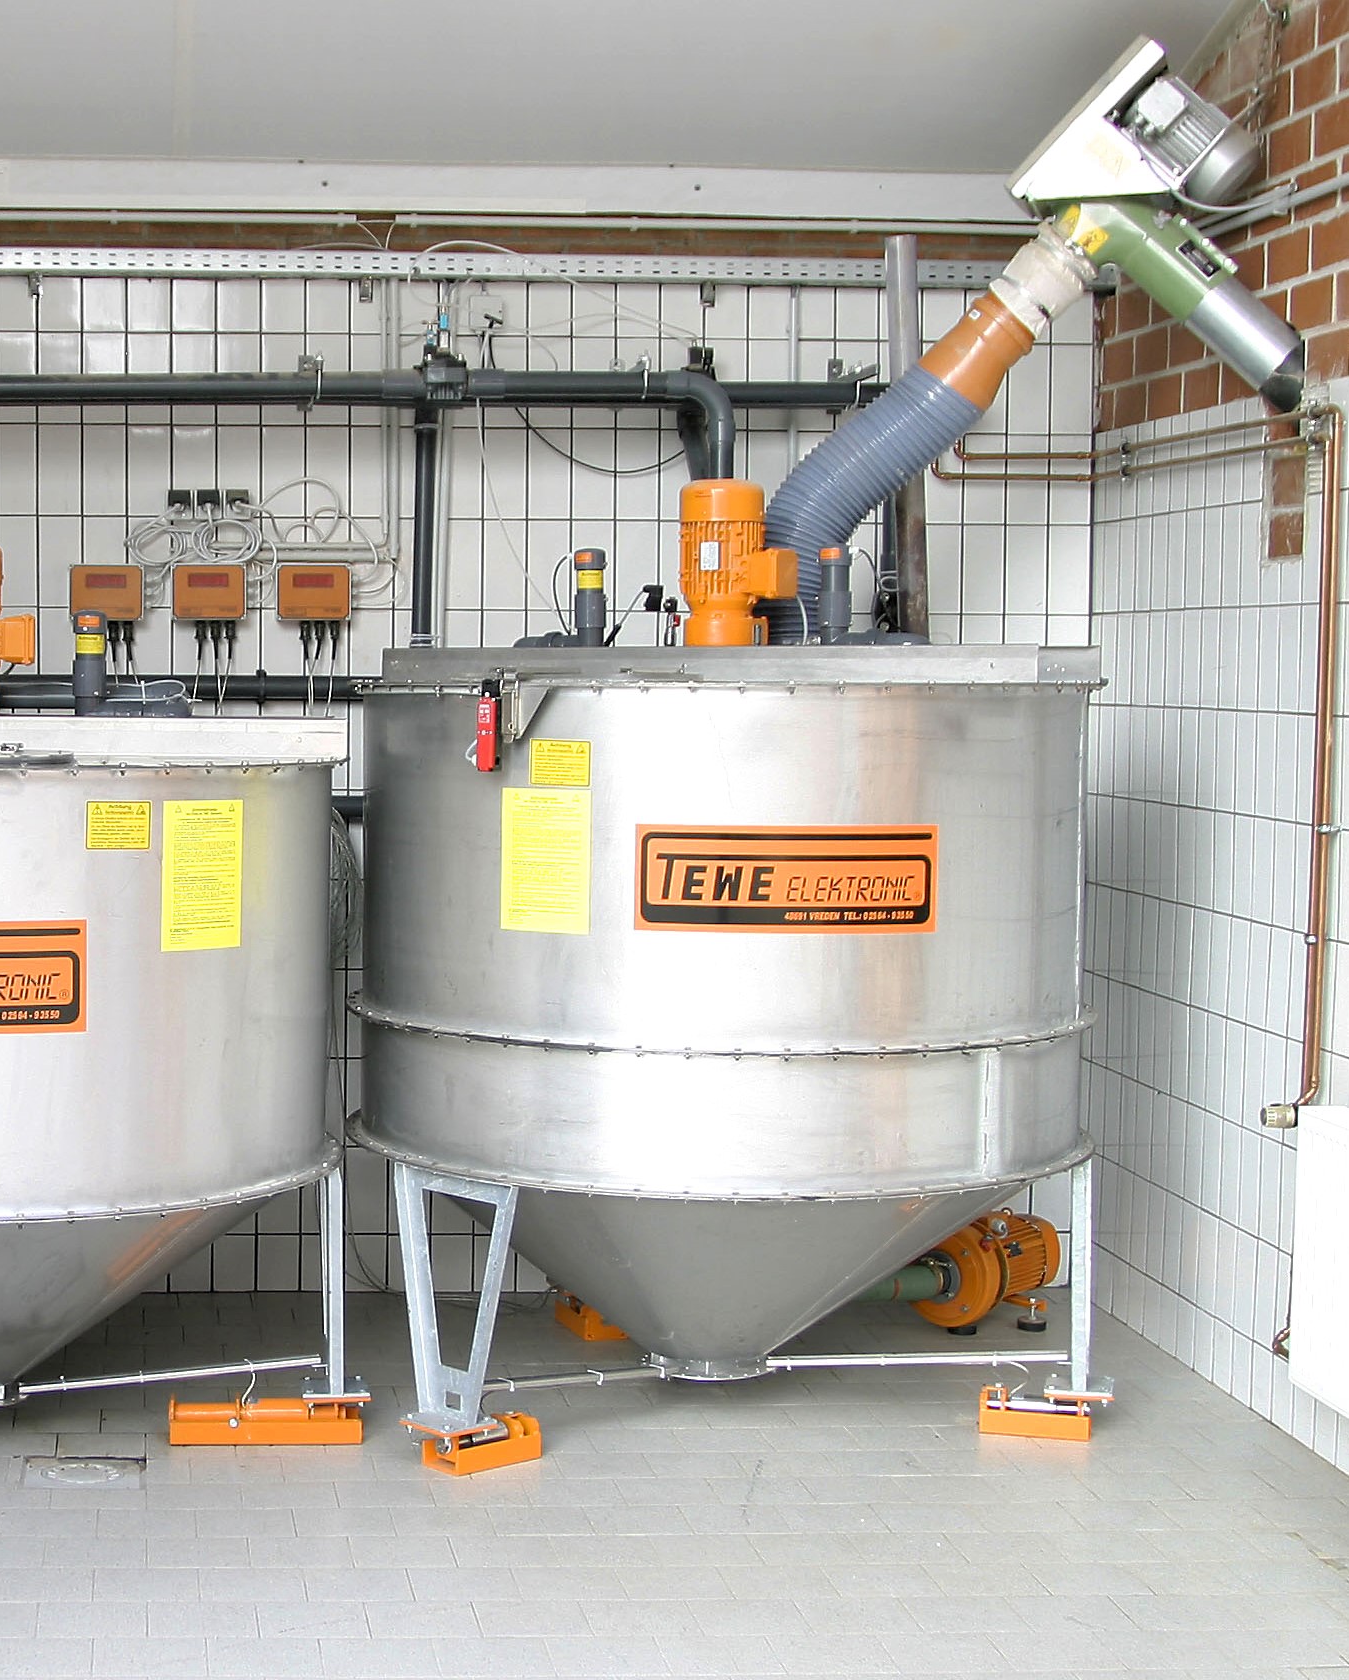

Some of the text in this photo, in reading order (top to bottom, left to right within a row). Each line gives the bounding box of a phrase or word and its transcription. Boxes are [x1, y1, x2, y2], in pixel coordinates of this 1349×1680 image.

[656, 853, 915, 902] TEWE ELEKTRONIC
[809, 912, 840, 921] VREDEN
